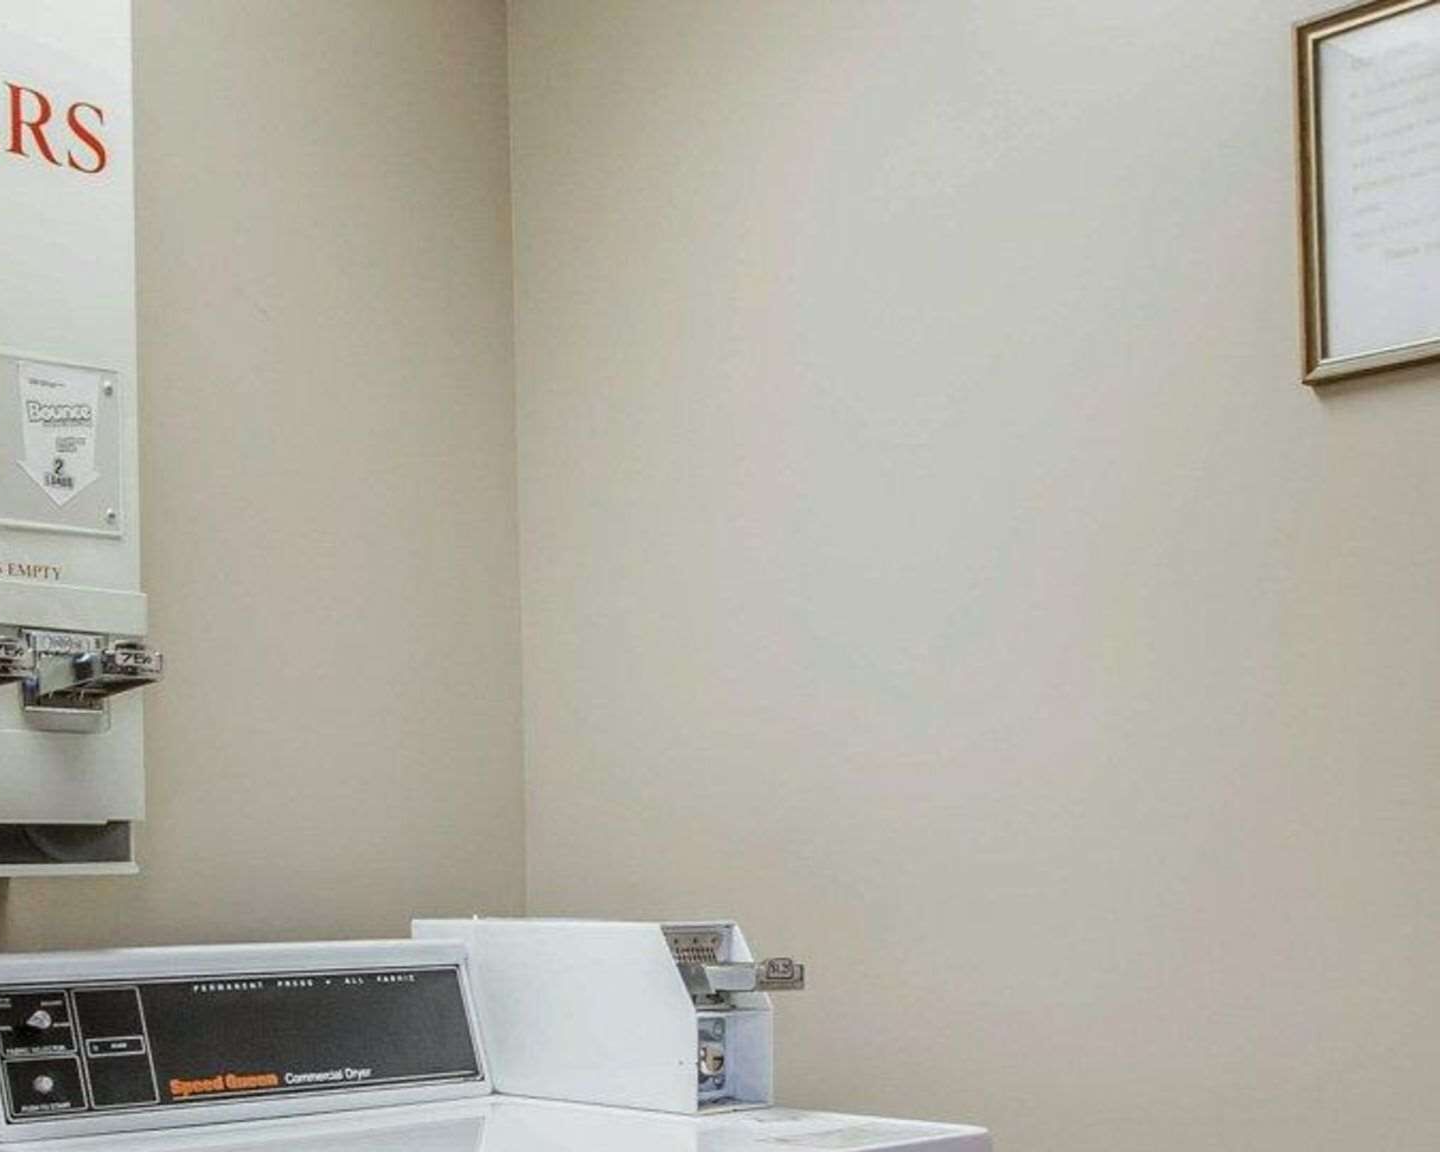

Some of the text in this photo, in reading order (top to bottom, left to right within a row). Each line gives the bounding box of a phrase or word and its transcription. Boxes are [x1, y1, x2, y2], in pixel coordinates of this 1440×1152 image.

[53, 459, 64, 476] 2
[8, 563, 63, 581] EMPTY
[169, 1067, 372, 1098] Speed Queen Commercial Dryer
